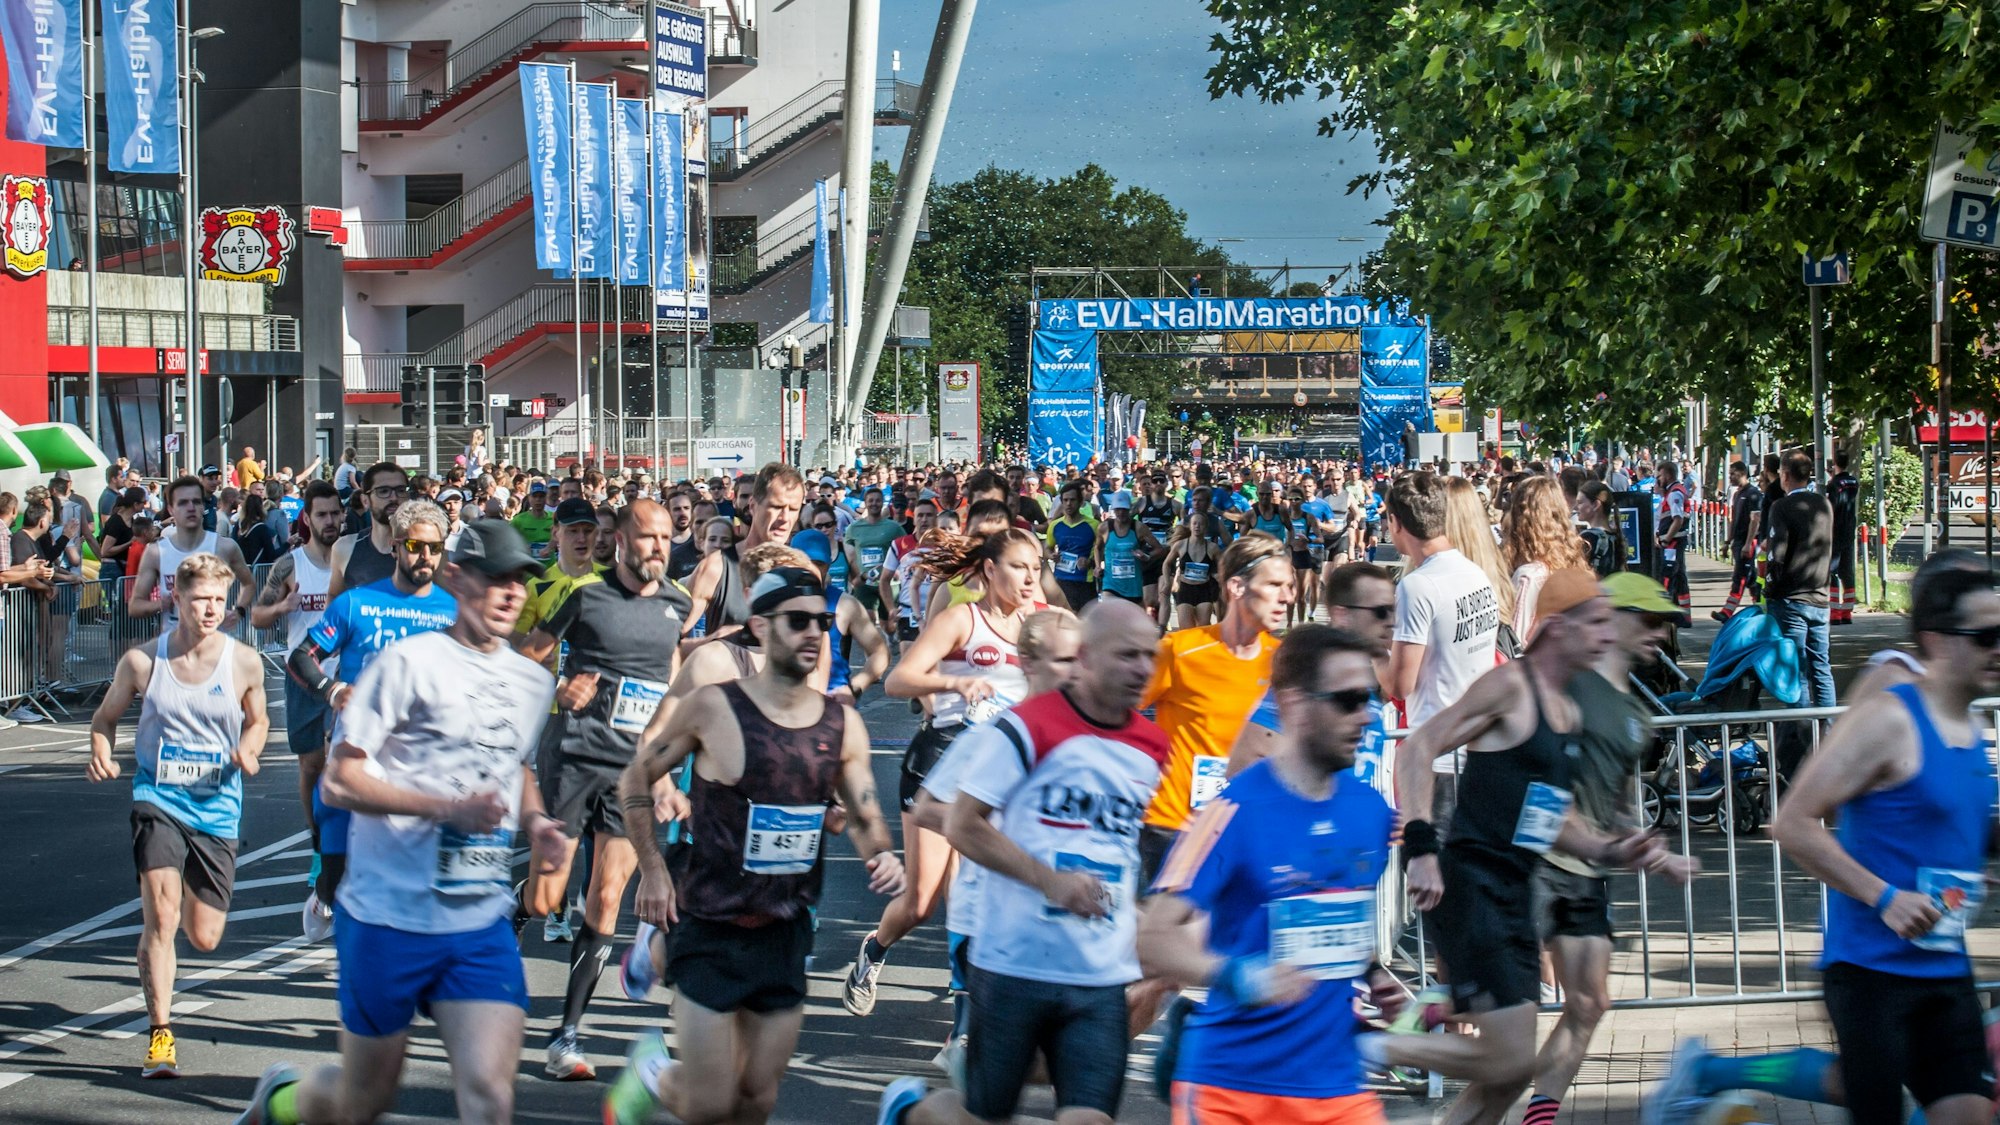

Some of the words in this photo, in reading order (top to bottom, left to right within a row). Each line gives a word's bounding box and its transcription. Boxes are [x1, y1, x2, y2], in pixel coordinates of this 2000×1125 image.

[657, 16, 670, 36] DIE
[670, 17, 703, 45] GRÖSSTE
[657, 40, 694, 66] AUSWAHL
[658, 65, 673, 86] DER
[673, 68, 704, 93] REGION!
[229, 214, 252, 223] 1904
[222, 245, 261, 254] BAYER
[1077, 299, 1381, 328] EVL-HalbMarathon
[167, 351, 187, 370] SERVI
[199, 352, 208, 370] ST
[1038, 362, 1091, 371] SPORTPARK
[1368, 359, 1420, 367] SPORTPARK
[698, 440, 754, 449] DURCHGANG
[360, 604, 457, 627] EVL-HalbMaratho
[1455, 596, 1469, 620] NO
[1453, 617, 1474, 643] JUST
[178, 765, 201, 777] 901
